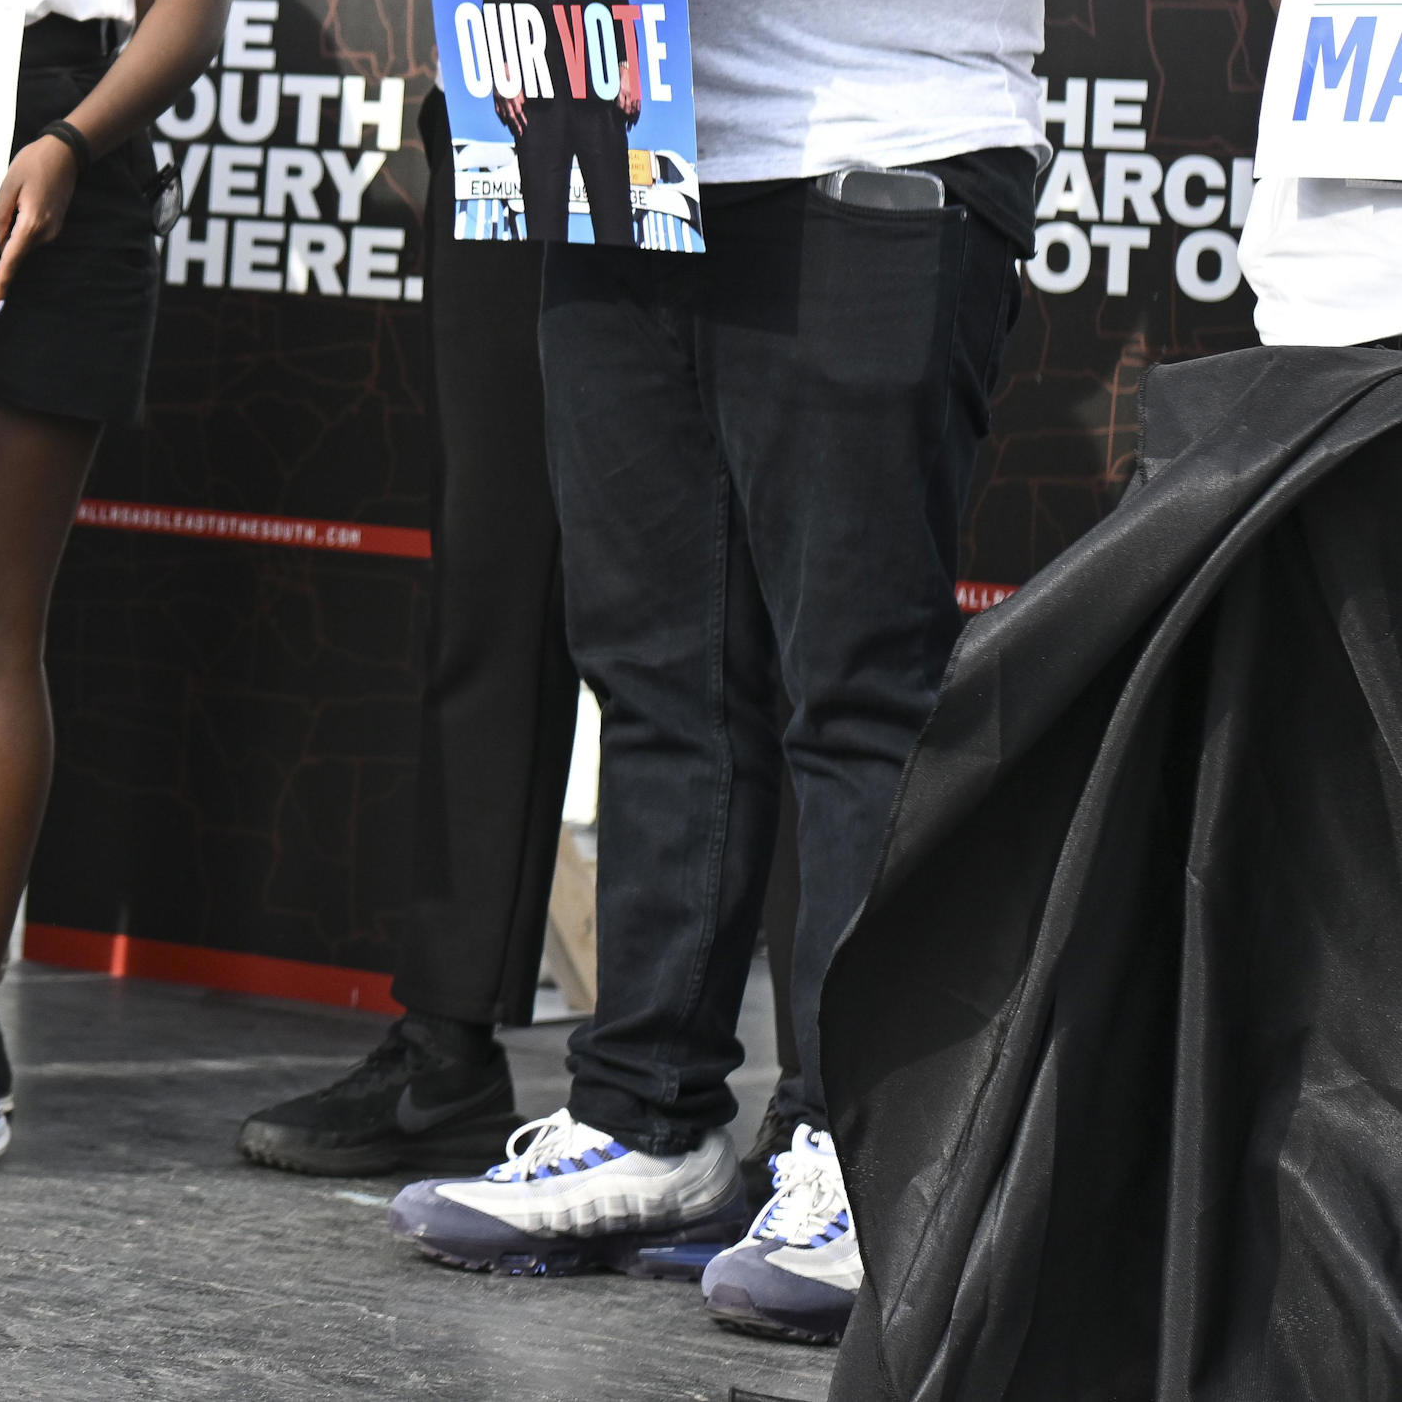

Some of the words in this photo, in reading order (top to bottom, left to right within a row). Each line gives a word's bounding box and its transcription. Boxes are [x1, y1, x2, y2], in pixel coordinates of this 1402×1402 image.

[453, 2, 554, 99] OUR
[553, 3, 672, 101] VOTE
[1292, 16, 1402, 122] MA
[156, 72, 405, 152] OUTH
[1037, 76, 1148, 150] HE
[152, 142, 388, 222] VERY
[471, 180, 523, 198] EDMUN
[1035, 149, 1254, 229] ARC
[154, 215, 425, 303] HERE.
[1024, 220, 1151, 297] OT
